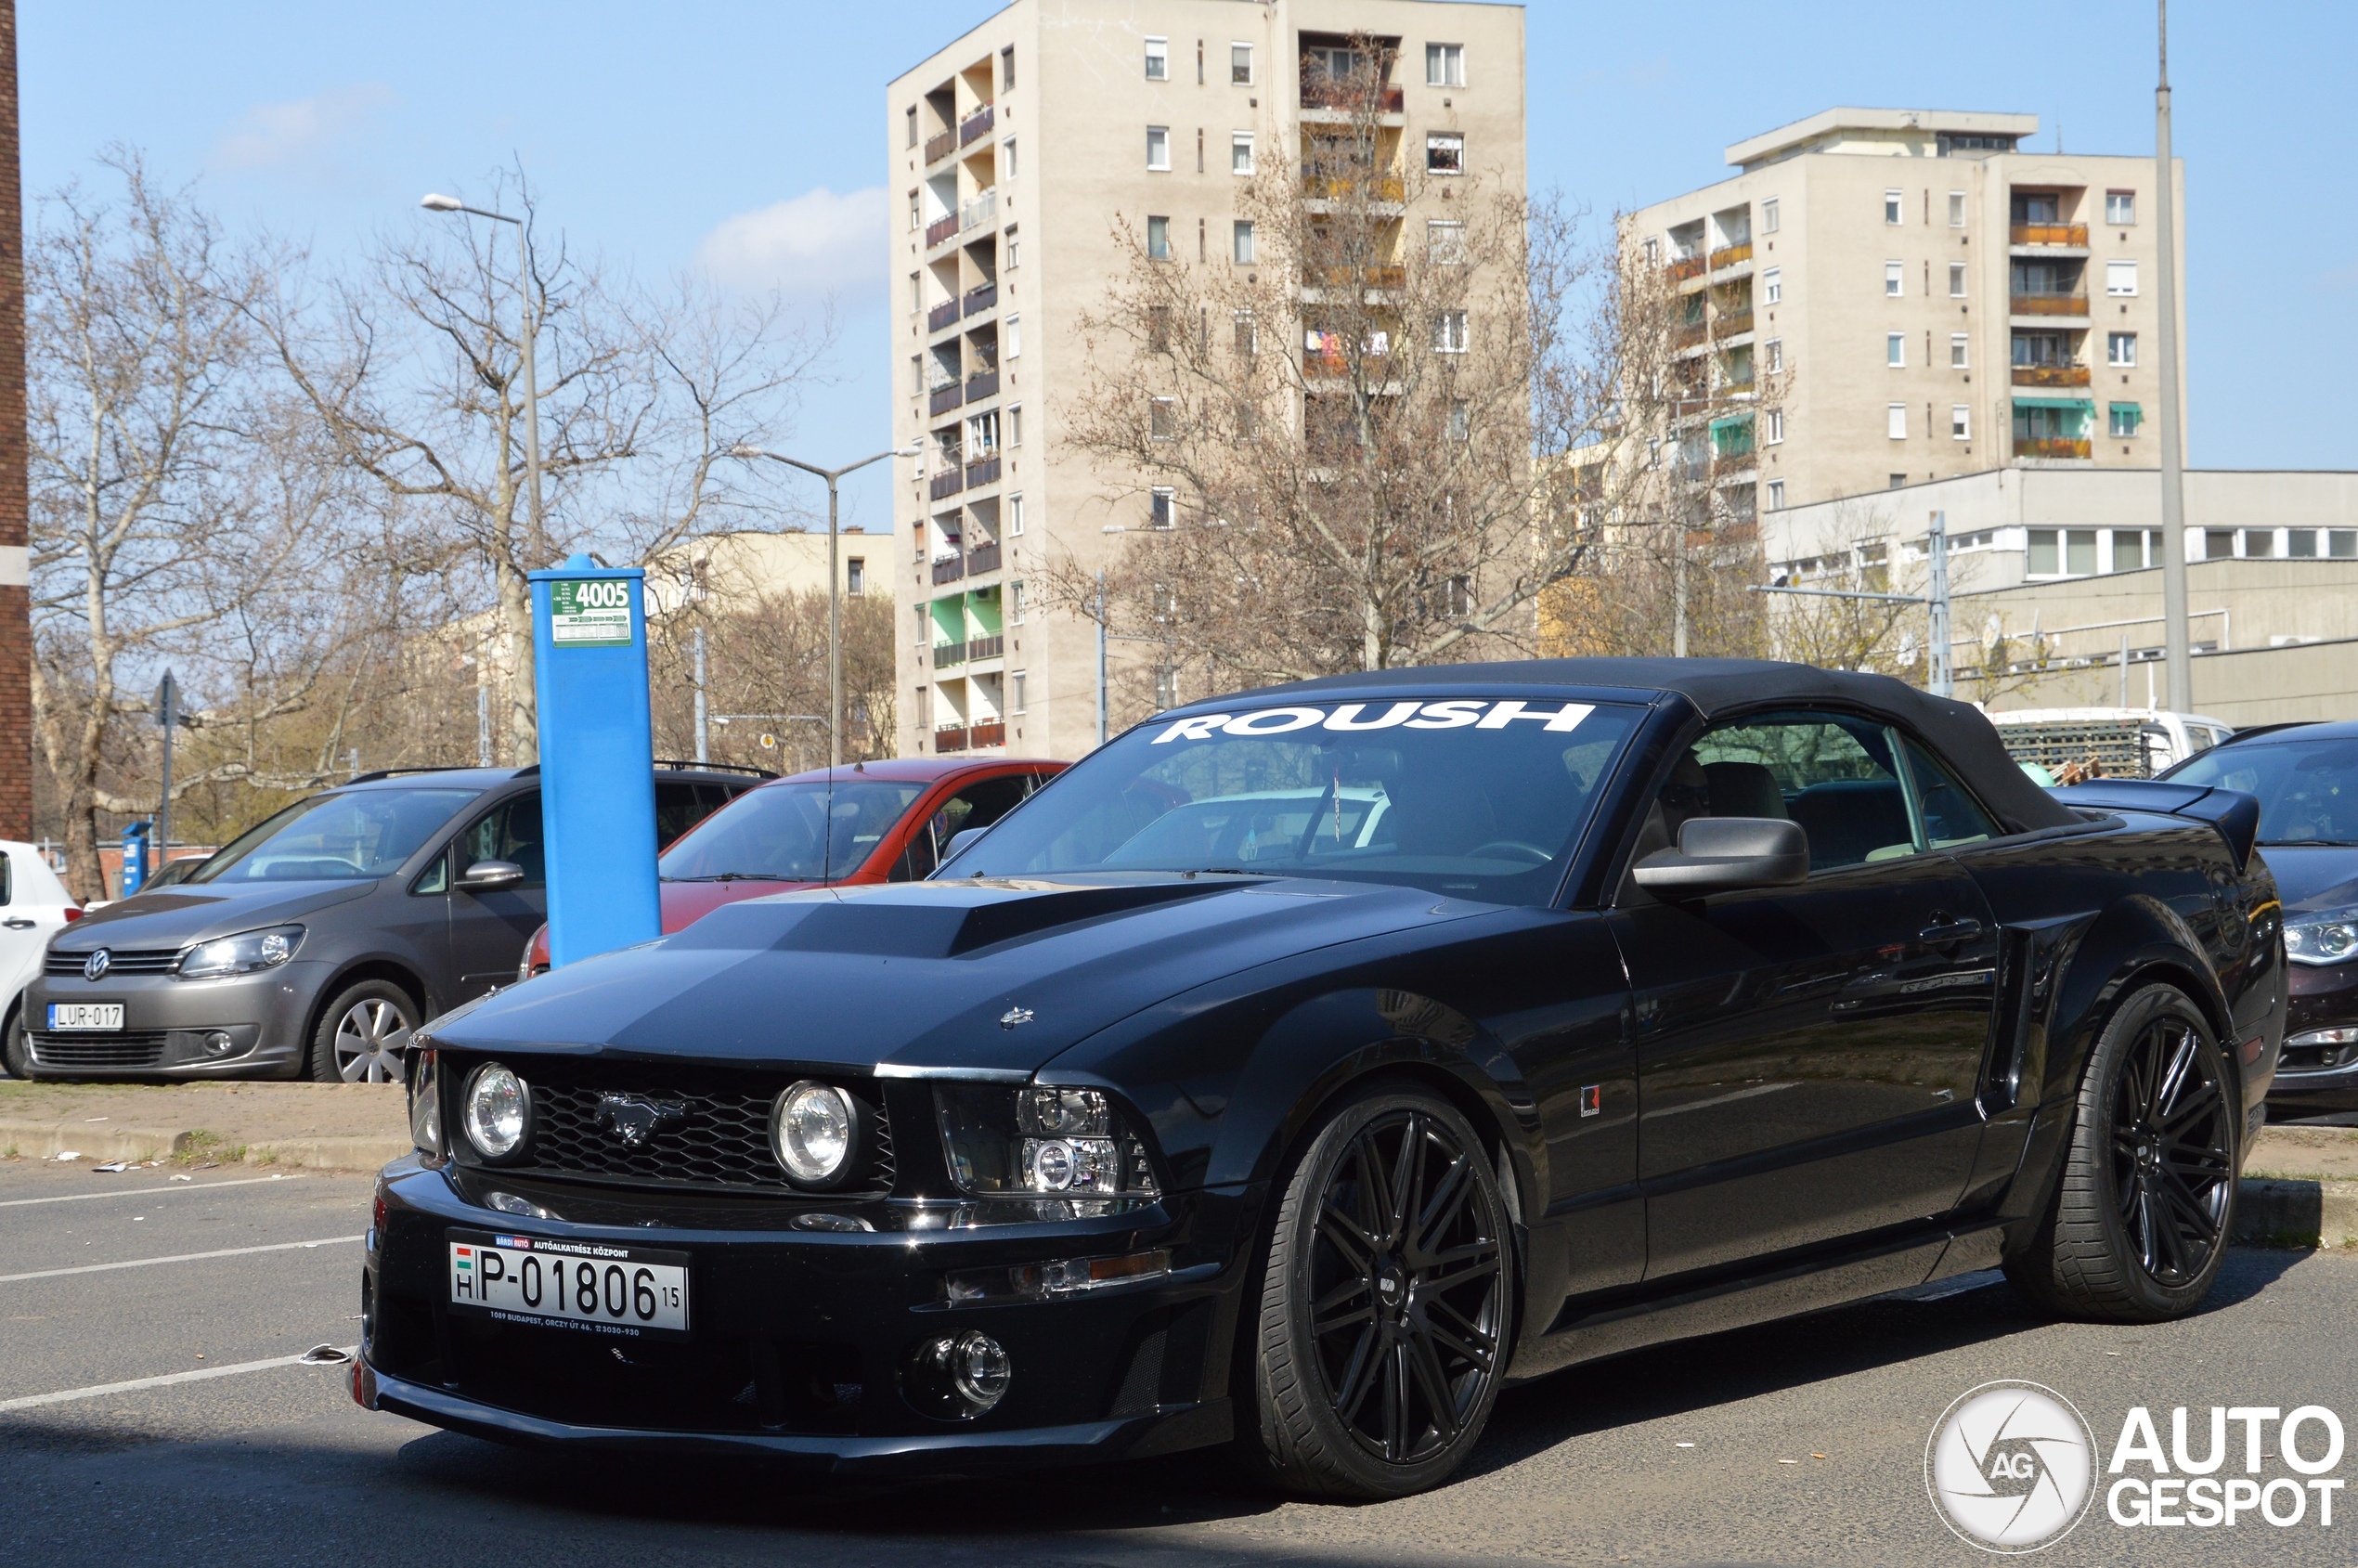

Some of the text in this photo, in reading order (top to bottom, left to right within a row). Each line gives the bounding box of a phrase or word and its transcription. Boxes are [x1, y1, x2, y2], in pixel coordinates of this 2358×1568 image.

[576, 582, 628, 608] 4005
[1150, 700, 1598, 745] ROUSH
[58, 1007, 120, 1025] LUR-017
[496, 1236, 529, 1249] BÁRDI AUTÓ
[534, 1240, 629, 1259] AUTÓALKATRÉSZ KÖZPONT
[457, 1273, 473, 1299] H
[481, 1251, 656, 1321] P-01806
[662, 1286, 680, 1308] 15
[490, 1311, 506, 1320] 1089
[507, 1314, 544, 1327] BUDAPEST,
[545, 1317, 569, 1328] ORCZY
[570, 1319, 579, 1329] ÚT
[580, 1323, 592, 1331] 46.
